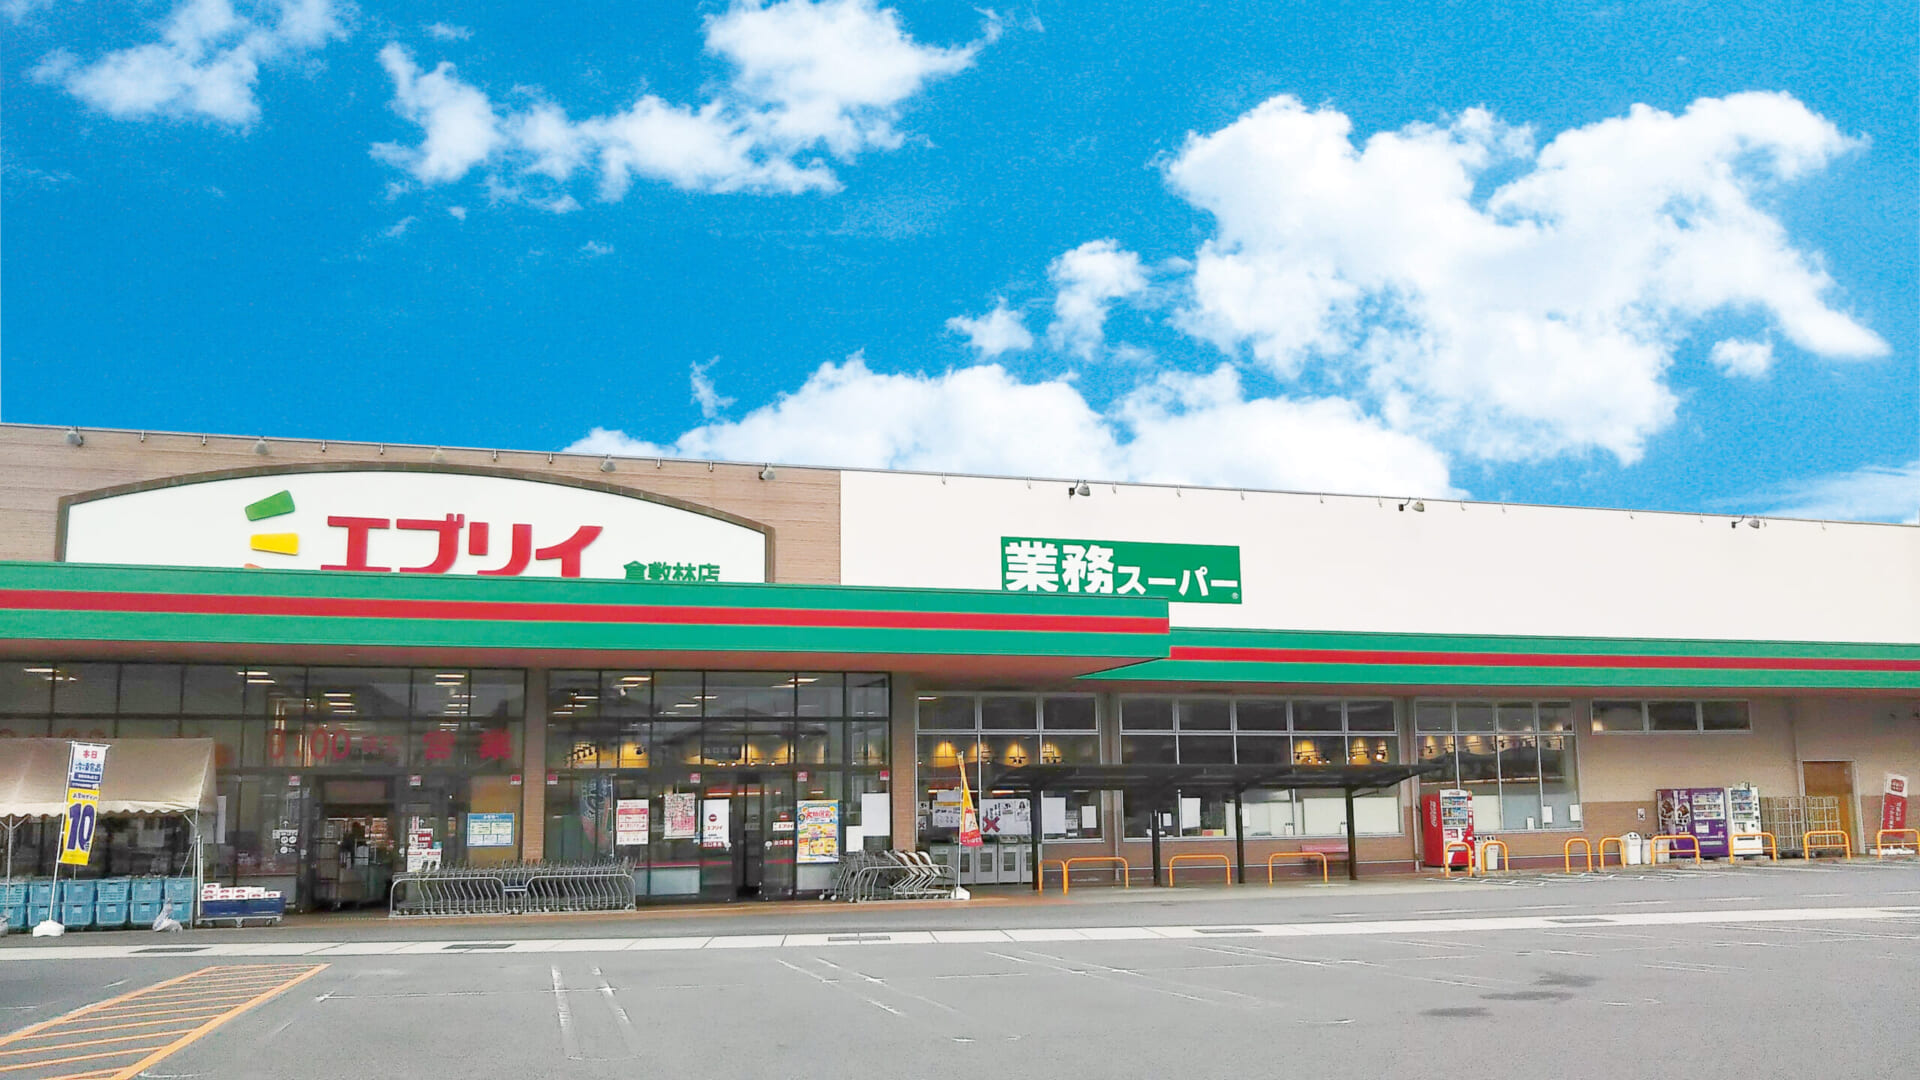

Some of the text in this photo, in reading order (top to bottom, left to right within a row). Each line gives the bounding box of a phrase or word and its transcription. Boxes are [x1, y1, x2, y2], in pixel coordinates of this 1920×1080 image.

[320, 513, 604, 578] エブリイ
[623, 560, 720, 582] 倉敷林店
[1005, 540, 1238, 597] 業務スーパー
[67, 803, 95, 850] 10
